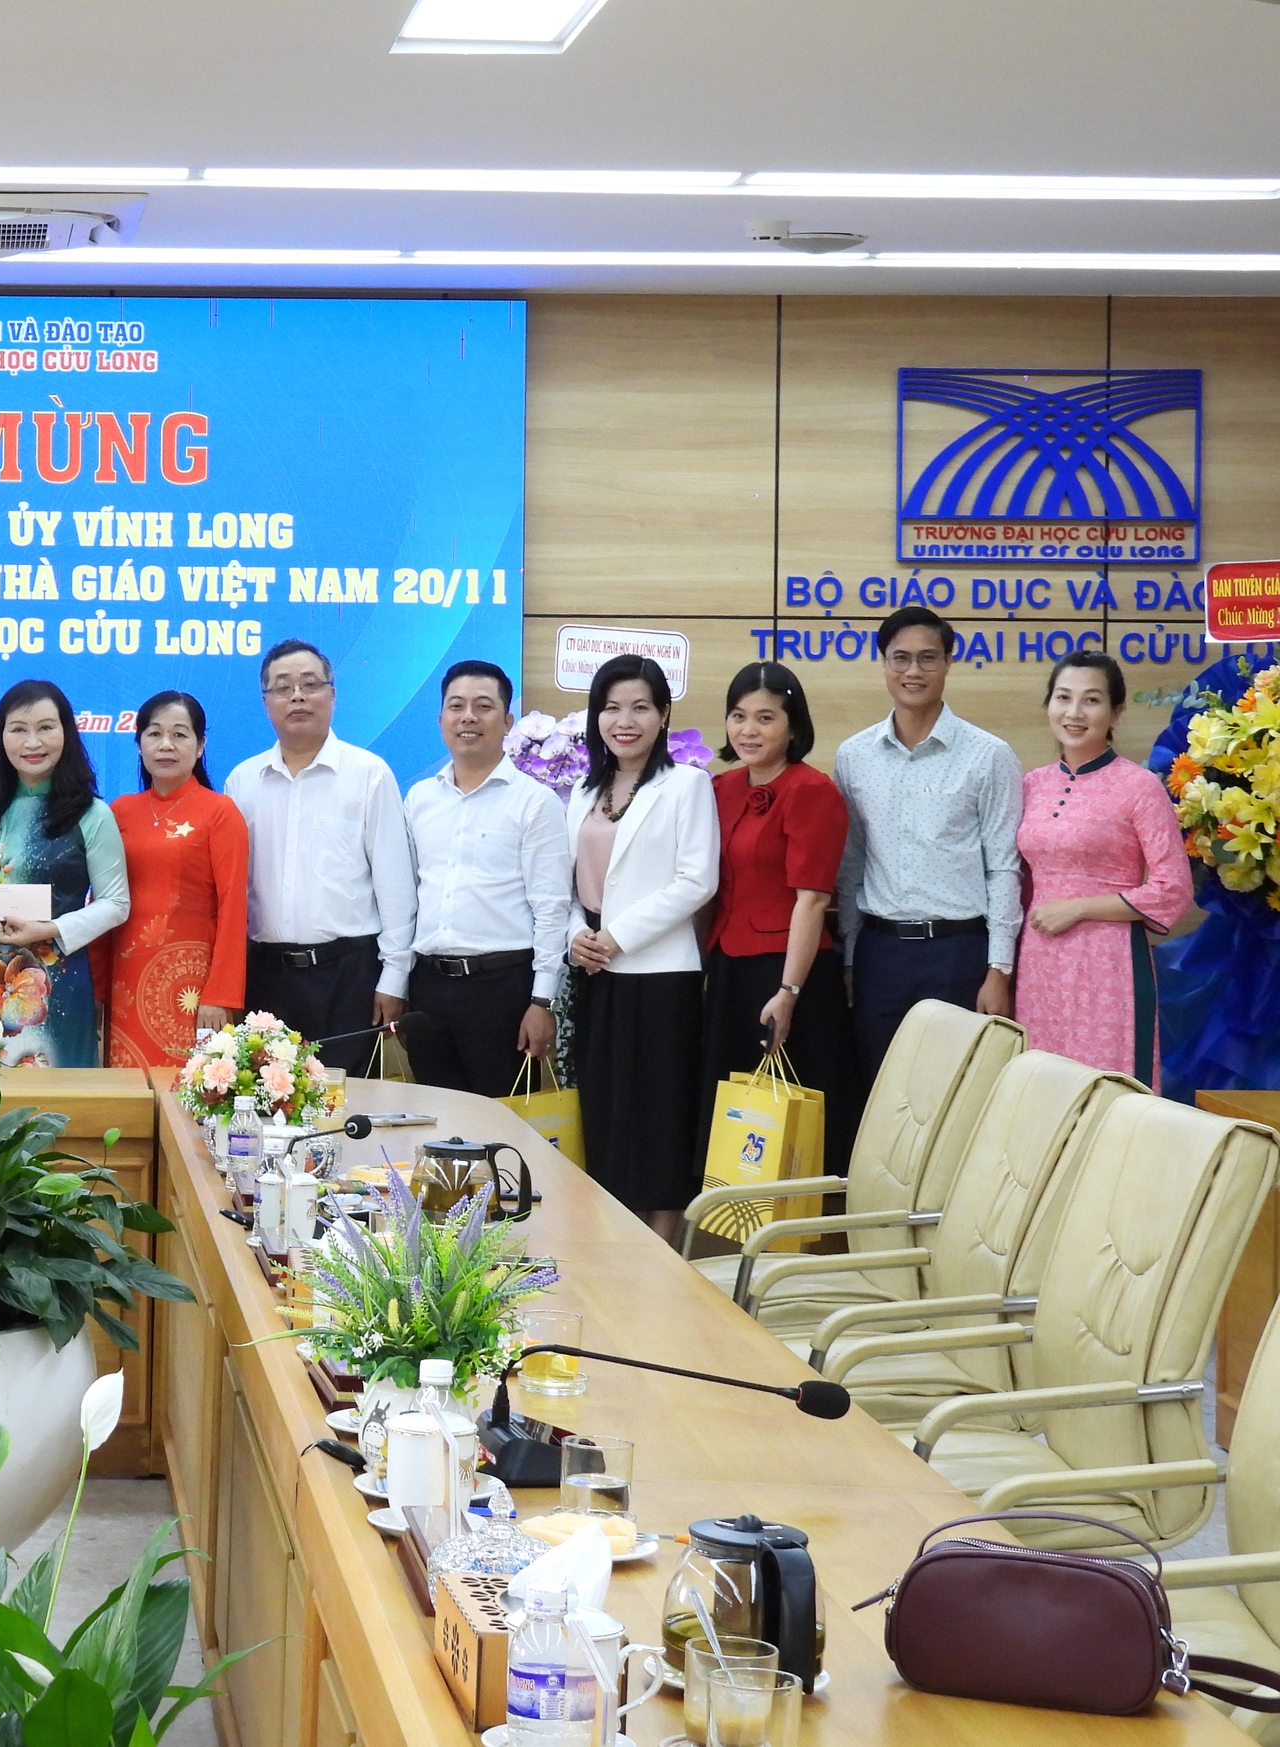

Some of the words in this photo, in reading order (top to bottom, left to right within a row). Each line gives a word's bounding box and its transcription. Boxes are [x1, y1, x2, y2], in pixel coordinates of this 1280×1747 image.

[8, 318, 39, 341] VÀ
[45, 318, 90, 342] ĐÀO
[98, 323, 143, 346] TẠO
[44, 346, 90, 371] CỬU
[97, 352, 156, 371] LONG
[9, 501, 62, 547] ỦY
[73, 505, 174, 548] VĨNH
[187, 511, 294, 549] LONG
[913, 524, 996, 541] TRƯỜNG
[1002, 526, 1034, 544] ĐẠI
[1040, 526, 1080, 545] HỌC
[1134, 527, 1186, 542] LONG
[913, 544, 1034, 558] UNIVERSITY
[1129, 545, 1185, 558] LONG
[71, 558, 166, 603] GIÁO
[177, 559, 276, 610] VIỆT
[289, 568, 379, 604] NAM
[392, 567, 508, 609] 20/11
[786, 570, 843, 617] BỘ
[859, 568, 956, 608] GIÁO
[971, 578, 1052, 619] DỤC
[1066, 571, 1118, 611] VÀ
[1212, 578, 1232, 598] BAN
[1233, 574, 1263, 597] TUYÊN
[1217, 606, 1244, 626] Chúc
[1246, 605, 1275, 628] Mừng
[59, 610, 141, 655] CỬU
[155, 619, 262, 656] LONG
[566, 637, 577, 651] CTY
[751, 621, 879, 661] TRƯỜ
[1119, 624, 1207, 664] CỬU
[561, 658, 577, 674] Chúc
[76, 713, 111, 731] ăm
